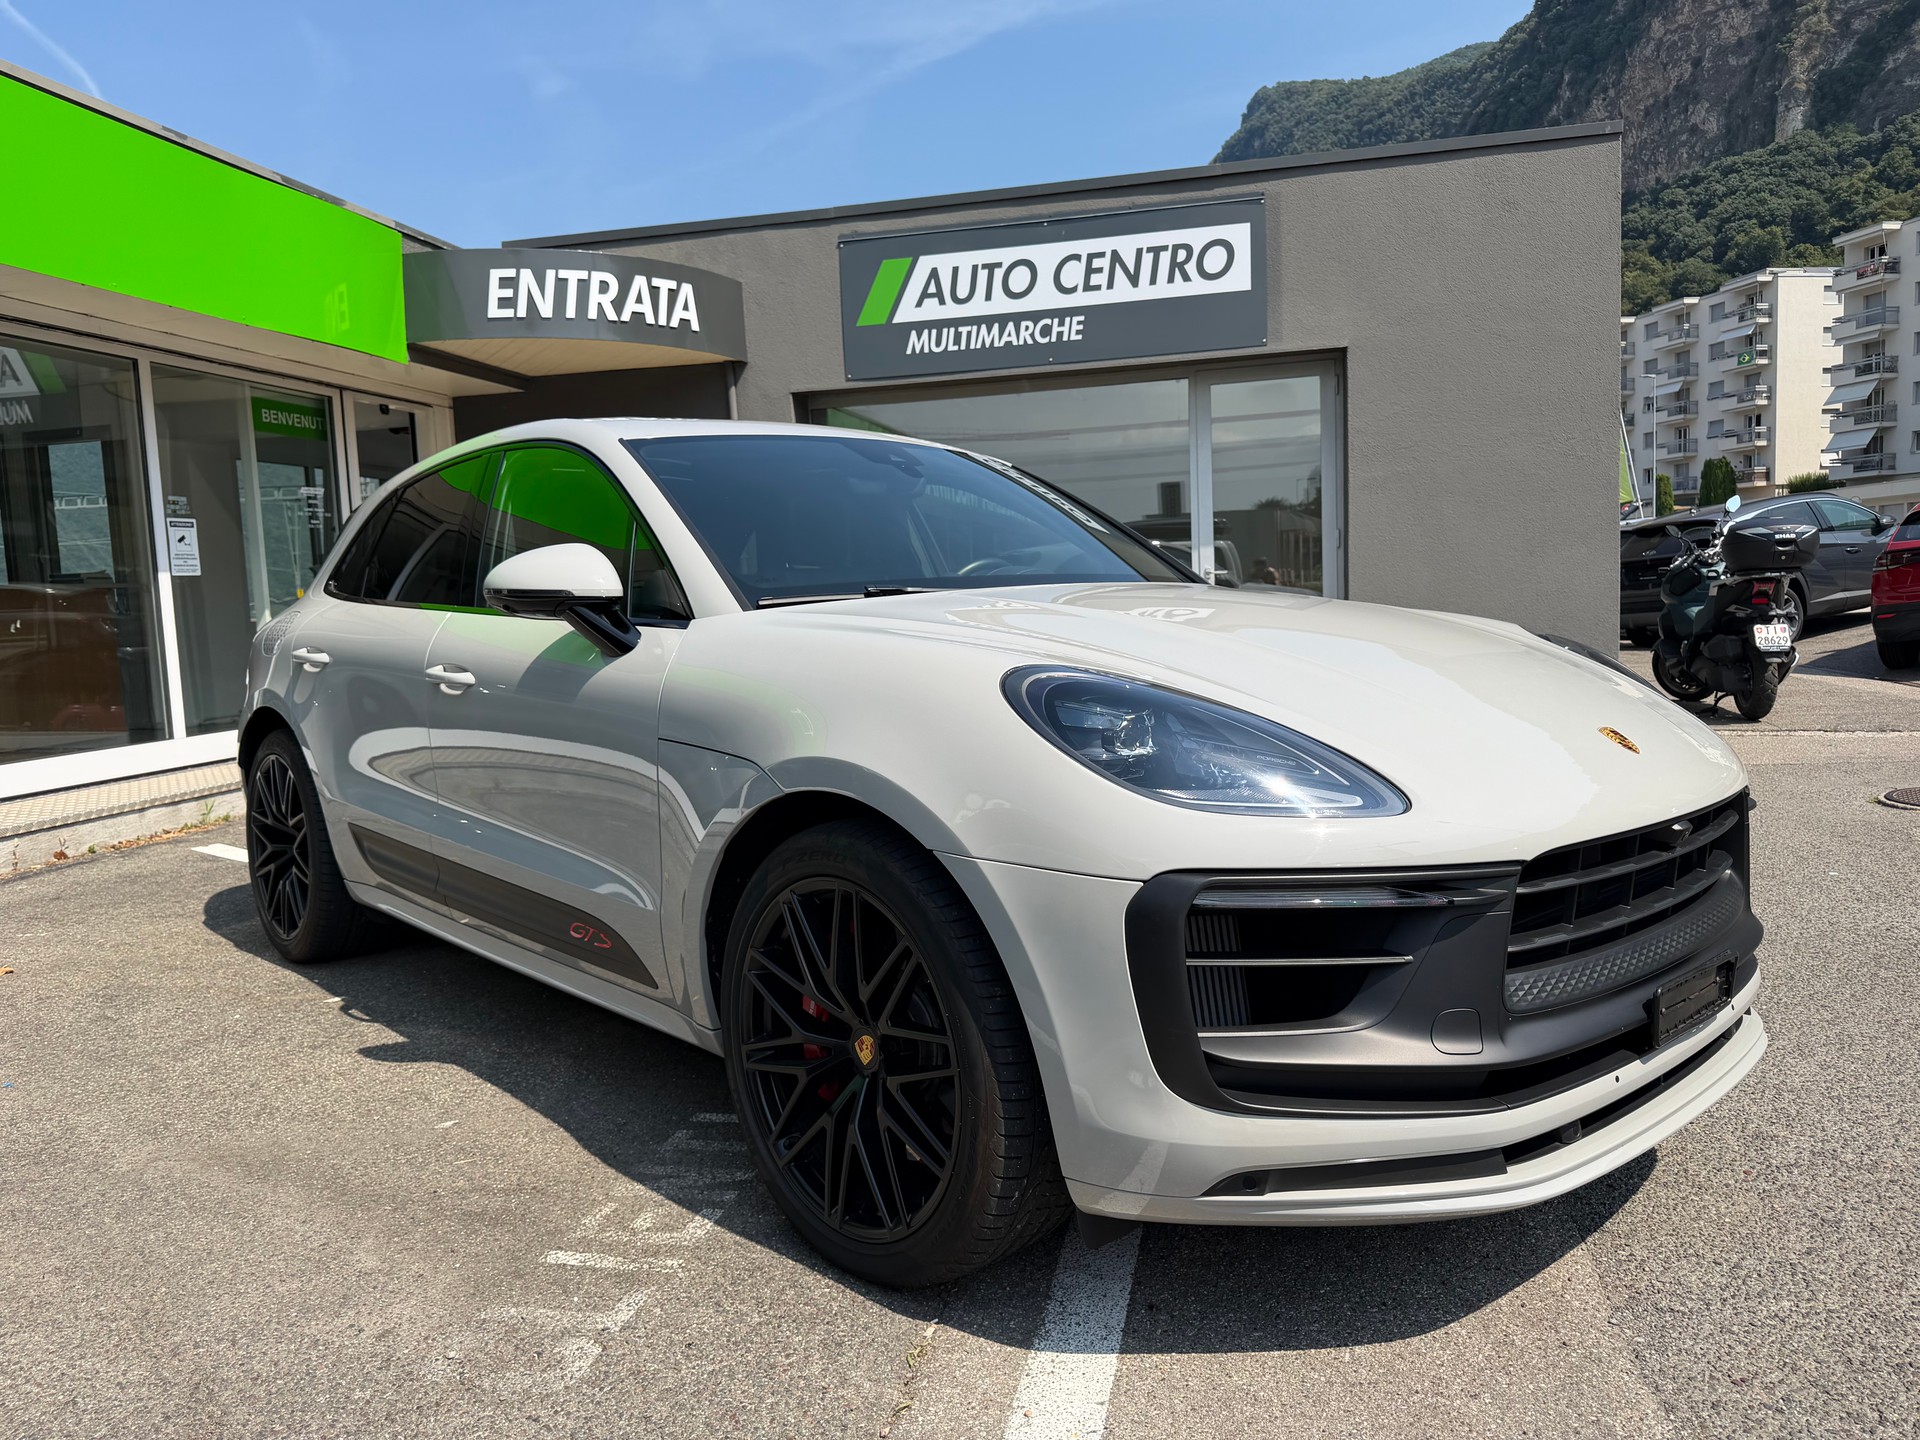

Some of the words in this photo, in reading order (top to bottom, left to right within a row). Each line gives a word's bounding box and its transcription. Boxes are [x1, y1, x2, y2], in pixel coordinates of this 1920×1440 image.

[914, 258, 1038, 309] AUTO
[1053, 238, 1235, 295] CENTRO
[487, 268, 700, 332] ENTRATA
[905, 315, 1085, 355] MULTIMARCHE
[1757, 635, 1788, 646] 28629
[1764, 625, 1777, 635] TI
[1256, 755, 1296, 766] PORSCHE
[570, 922, 613, 949] GTS
